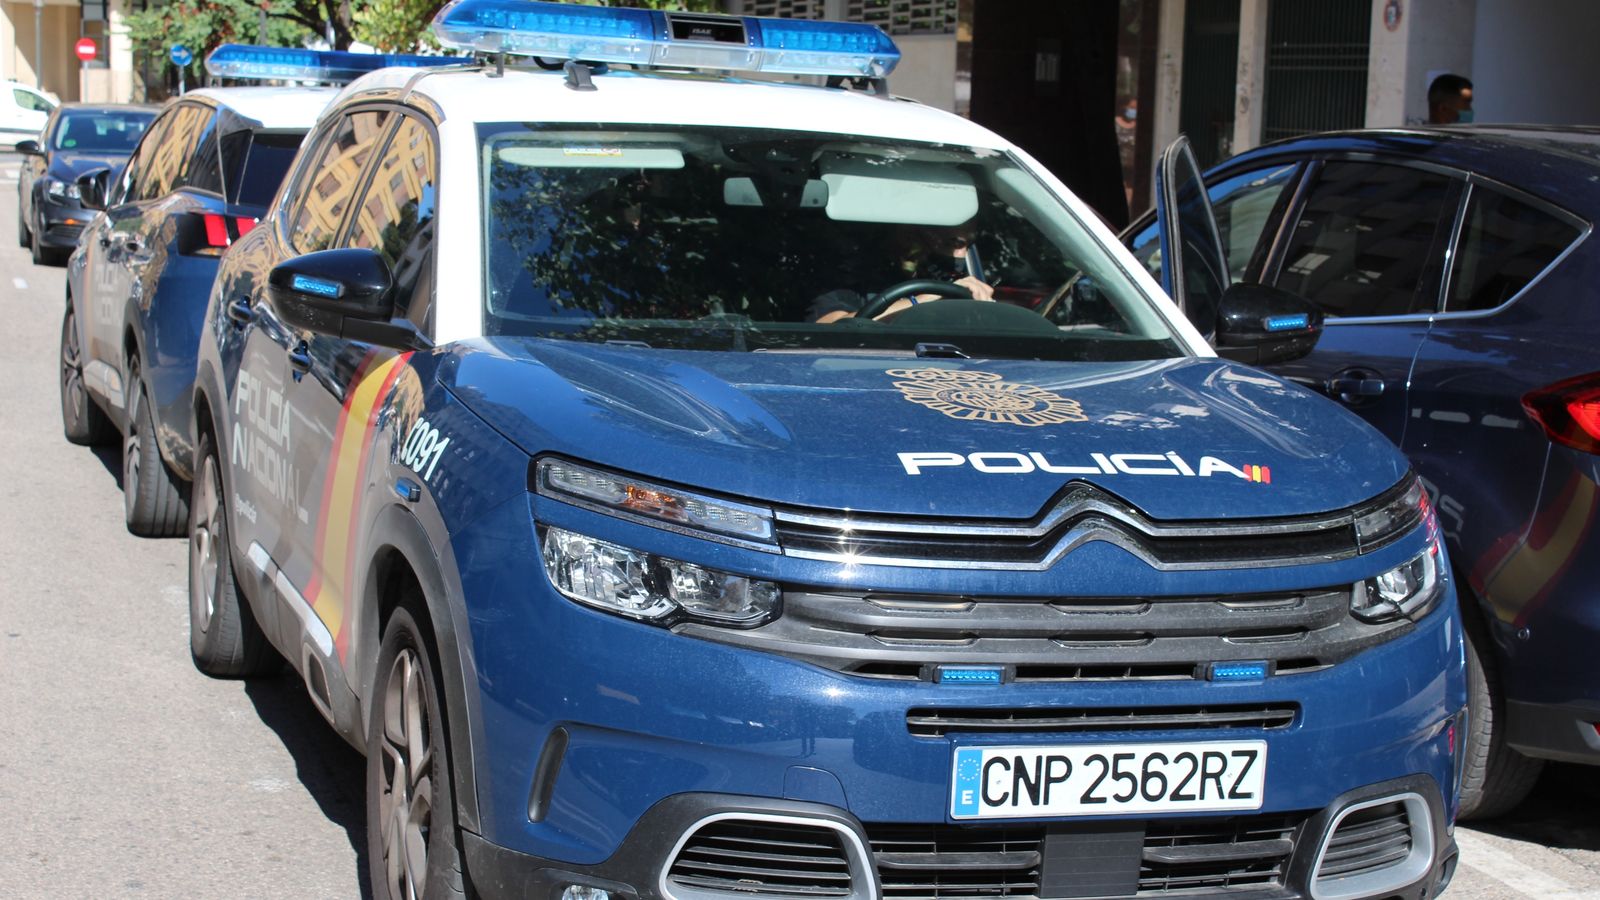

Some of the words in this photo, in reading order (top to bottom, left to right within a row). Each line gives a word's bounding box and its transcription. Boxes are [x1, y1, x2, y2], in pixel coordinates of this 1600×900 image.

[232, 421, 309, 525] NACIONAL
[897, 451, 1251, 479] POLICÍA
[961, 790, 973, 805] E
[981, 754, 1073, 807] CNP
[1080, 750, 1258, 804] 2562RZ
